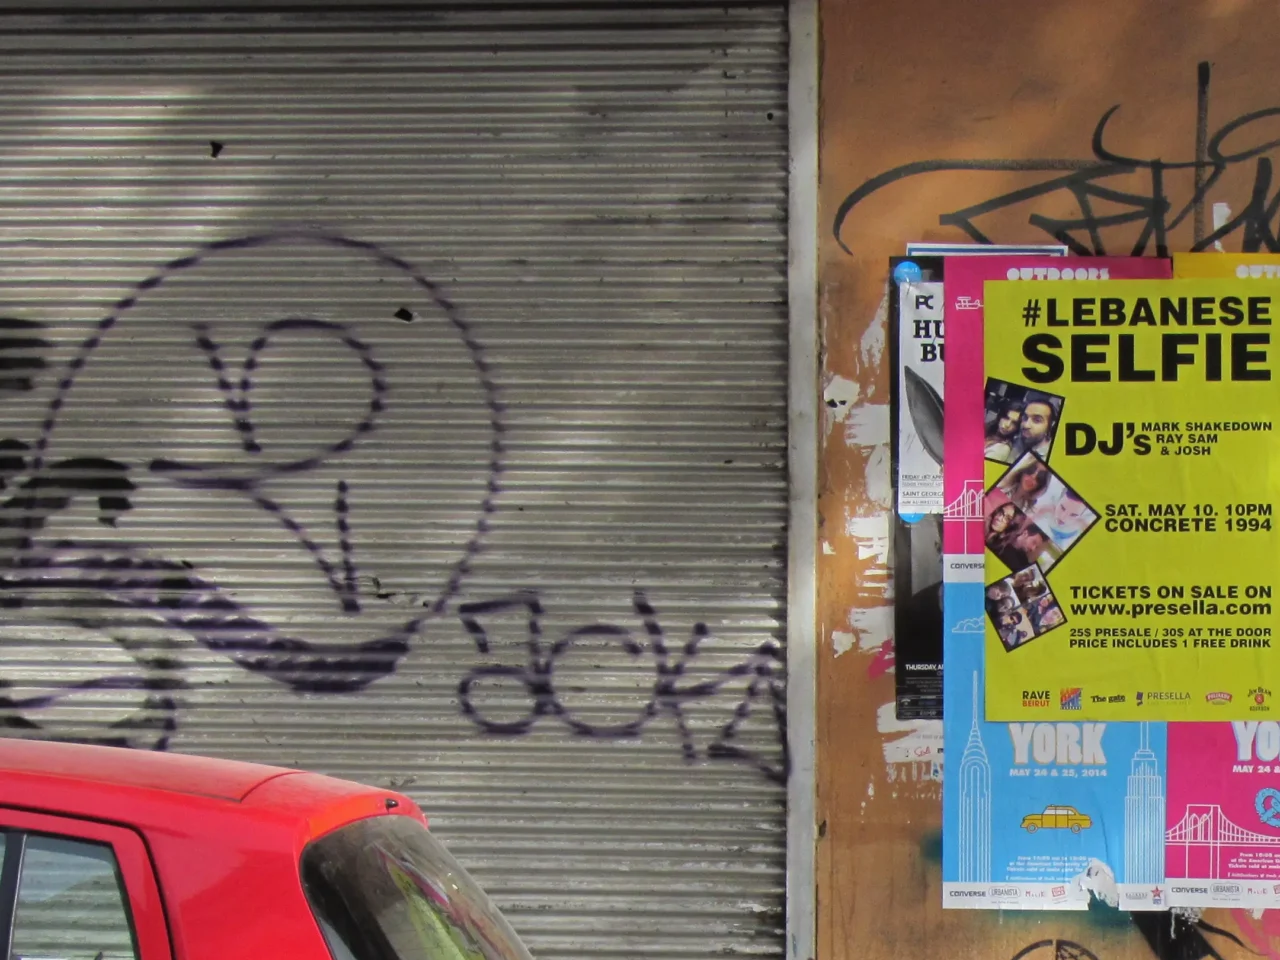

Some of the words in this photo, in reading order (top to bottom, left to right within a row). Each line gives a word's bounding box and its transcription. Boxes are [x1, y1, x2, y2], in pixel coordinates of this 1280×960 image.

[1023, 297, 1271, 326] #LEBANESE
[1022, 333, 1271, 383] SELFIE
[1142, 422, 1179, 431] MARK
[1186, 422, 1271, 431] SHAKEDOWN
[1066, 423, 1151, 455] DJ's
[1156, 434, 1183, 443] RAY
[1189, 434, 1217, 443] SAM
[1161, 446, 1169, 455] &
[1175, 446, 1210, 455] JOSH
[1106, 504, 1141, 516] SAT.
[1149, 504, 1186, 516] MAY
[1194, 504, 1218, 516] 10.
[1226, 504, 1271, 516] 10PM
[1105, 518, 1216, 532] CONCRETE
[1226, 518, 1271, 531] 1994
[1070, 586, 1150, 599] TICKETS
[1157, 586, 1183, 598] ON
[1191, 586, 1238, 598] SALE
[1245, 586, 1271, 598] ON
[1071, 600, 1271, 616] www.presella.com
[1070, 628, 1091, 637] 25$
[1096, 628, 1151, 636] PRESALE
[1155, 629, 1158, 637] /
[1163, 628, 1183, 637] 30$
[1189, 628, 1203, 636] AT
[1208, 628, 1231, 636] THE
[1237, 628, 1271, 636] DOOR
[1070, 639, 1107, 648] PRICE
[1113, 639, 1177, 648] INCLUDES
[1194, 639, 1225, 647] FREE
[1231, 639, 1270, 647] DRINK
[1022, 691, 1050, 699] RAVE
[1147, 692, 1191, 700] PRESELLA
[1007, 722, 1107, 764] YORK
[1233, 765, 1253, 773] MAY
